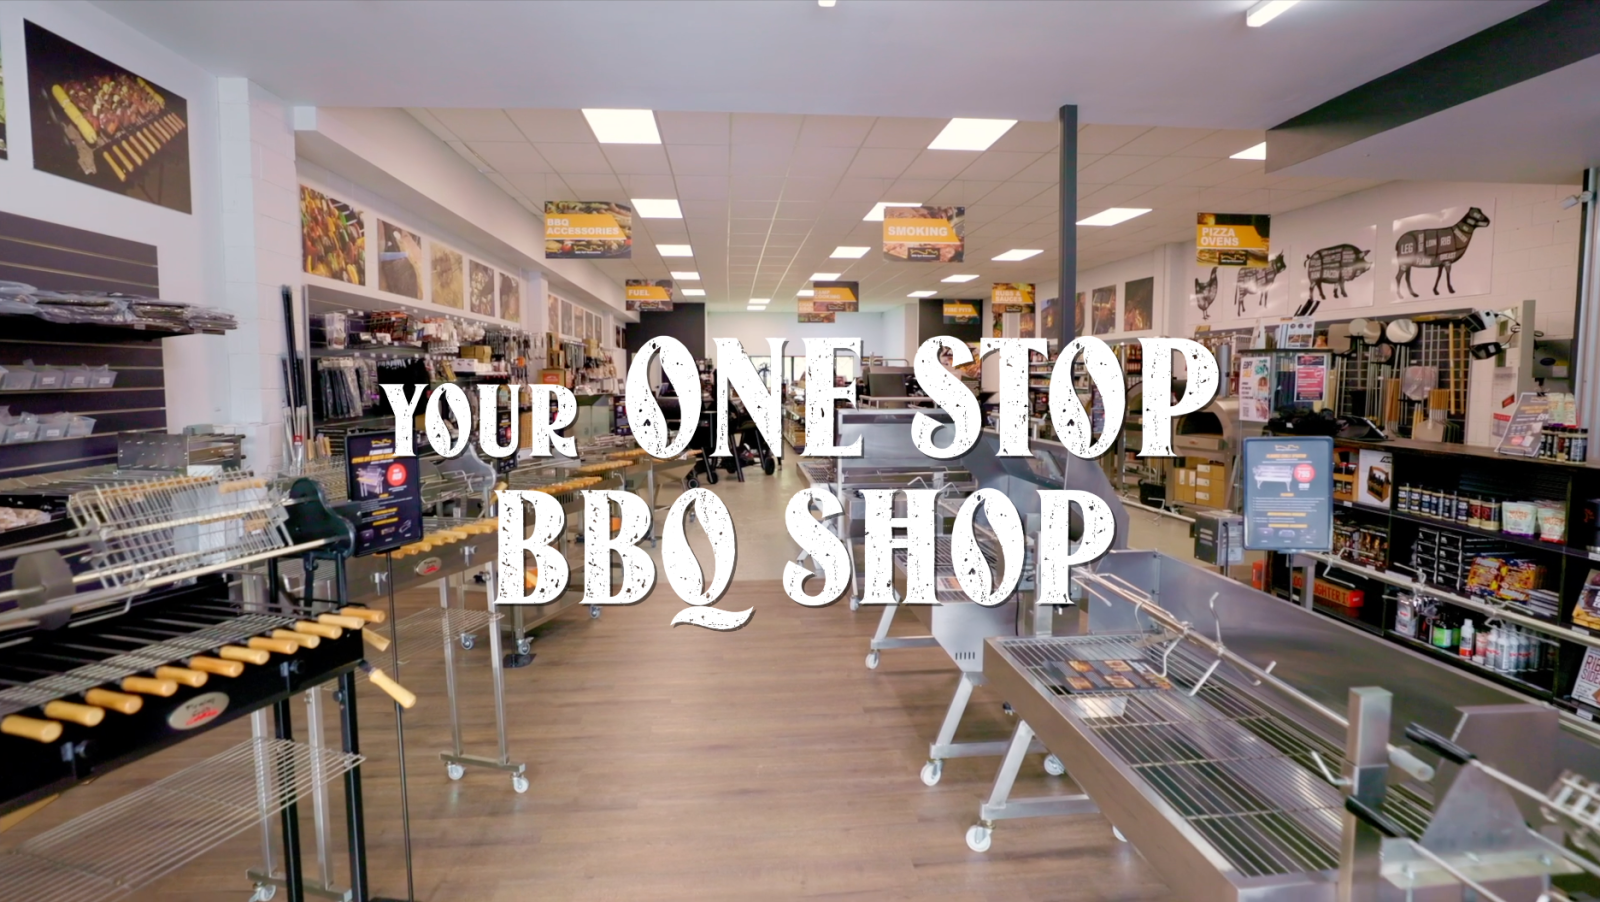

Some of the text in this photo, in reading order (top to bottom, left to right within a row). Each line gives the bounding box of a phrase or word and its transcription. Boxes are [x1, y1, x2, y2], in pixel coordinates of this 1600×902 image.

[547, 218, 569, 227] BBQ
[546, 227, 619, 235] ACCESSORIES
[888, 226, 948, 237] SMOKING
[1201, 227, 1235, 237] PIZZA
[1201, 237, 1239, 246] OVENS
[1401, 243, 1414, 254] LEG
